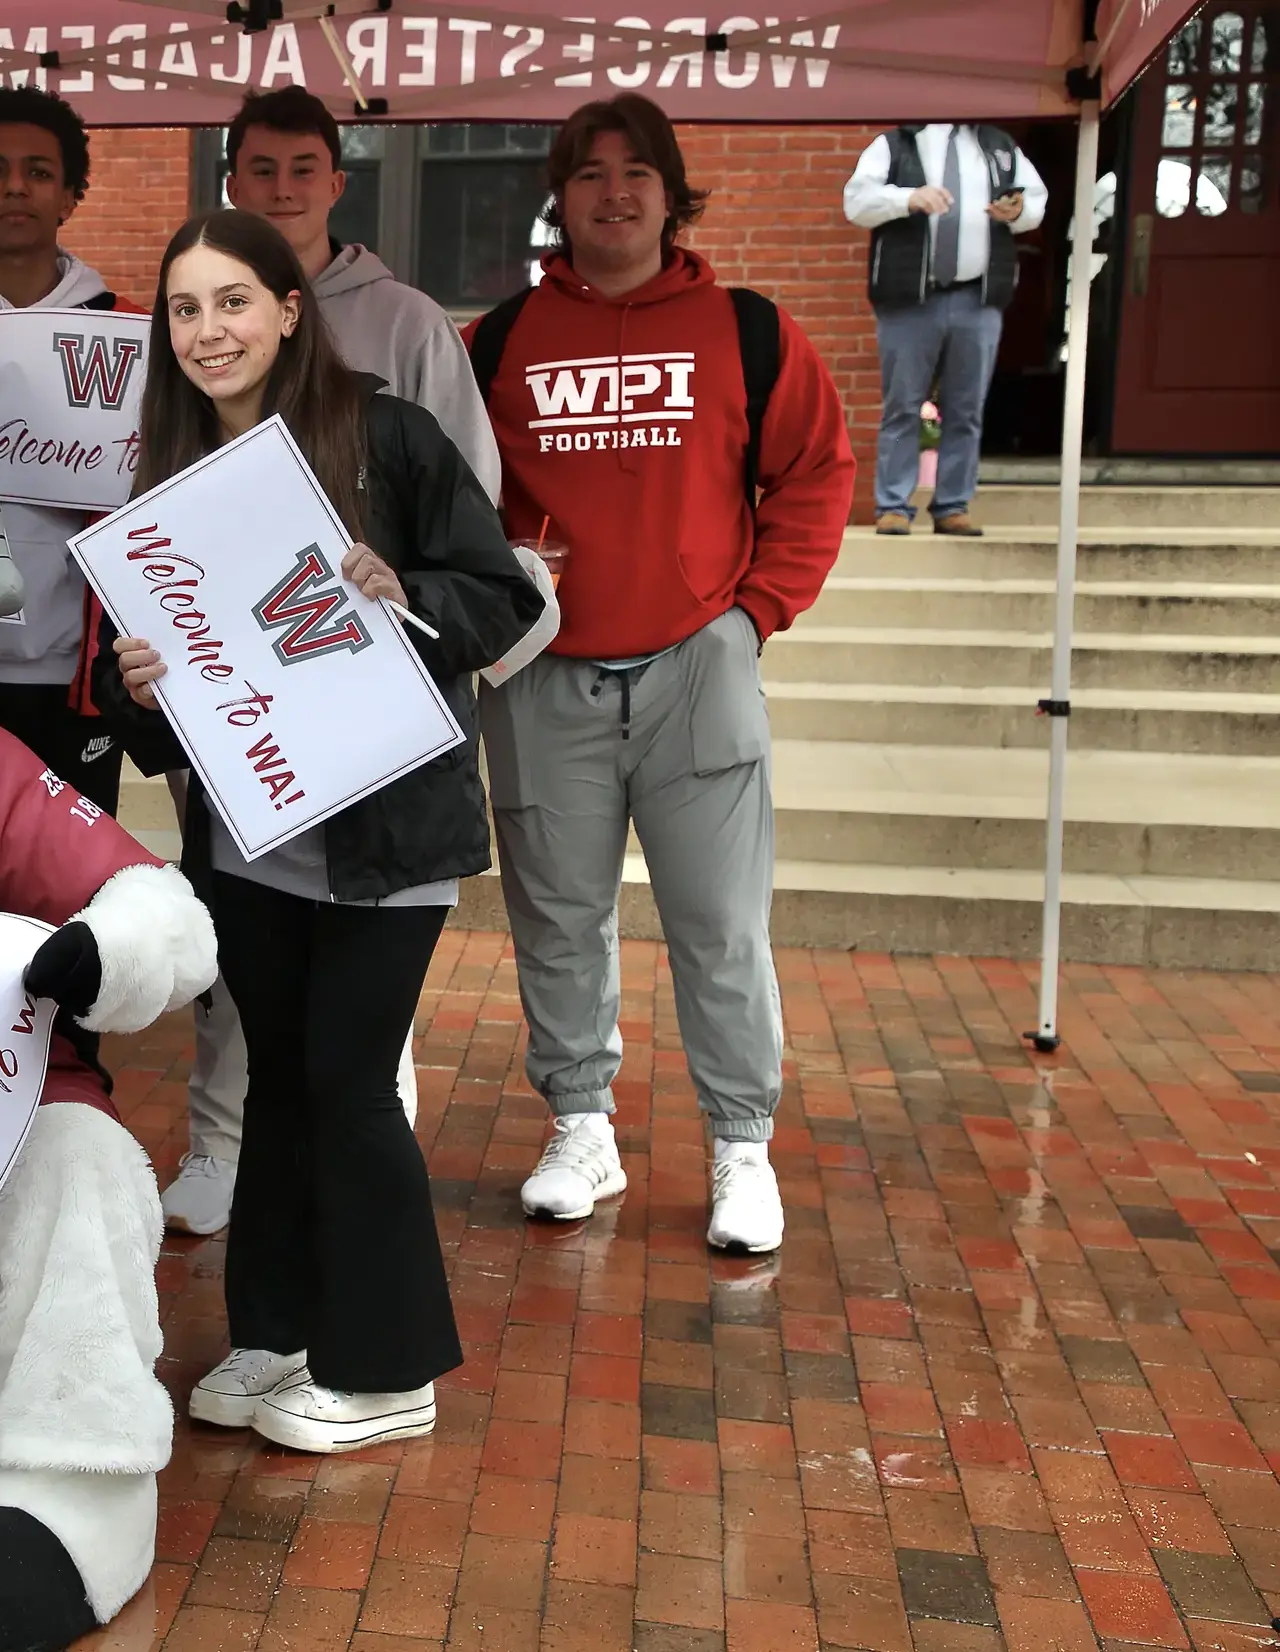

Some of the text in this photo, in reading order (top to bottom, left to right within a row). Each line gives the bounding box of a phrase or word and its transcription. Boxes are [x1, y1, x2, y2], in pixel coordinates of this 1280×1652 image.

[53, 332, 142, 410] W
[525, 360, 695, 416] WPI
[539, 426, 681, 453] FOOTBALL
[251, 541, 374, 667] W
[126, 522, 306, 811] Welcome to WA!
[86, 735, 111, 752] NIKE
[69, 796, 104, 827] 18
